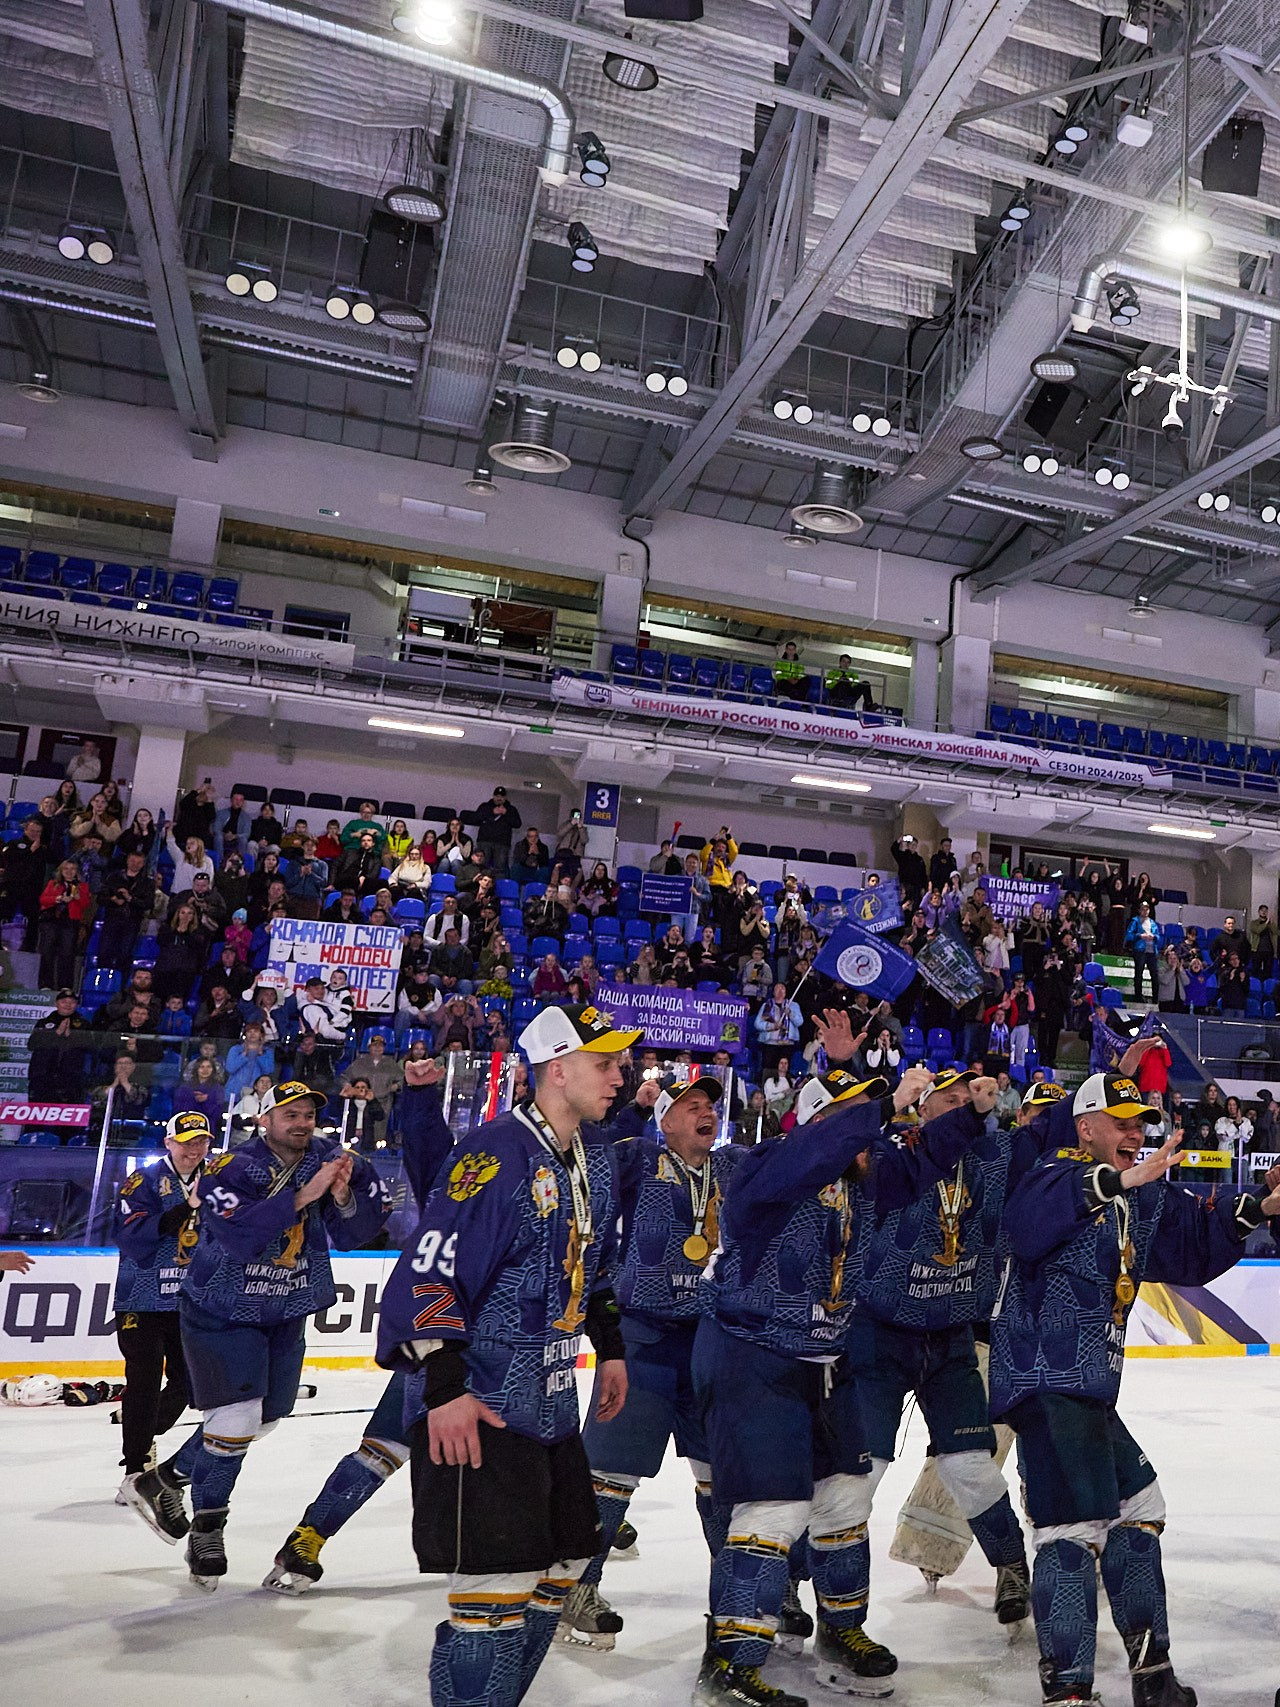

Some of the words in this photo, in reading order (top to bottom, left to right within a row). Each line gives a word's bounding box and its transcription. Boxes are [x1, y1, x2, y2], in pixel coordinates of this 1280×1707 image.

[0, 602, 60, 625] НИЯ
[207, 636, 256, 651] ЖИЛОЙ
[260, 644, 324, 661] КОМПЛЕКС
[632, 697, 718, 720] ЧЕМПИОНАТ
[721, 711, 777, 729] РОССИИ
[781, 720, 800, 732] ПО
[804, 723, 858, 741] ХОККЕЮ
[872, 733, 932, 751] ЖЕНСКАЯ
[936, 742, 1008, 762] ХОККЕЙНАЯ
[1010, 753, 1040, 767] ЛИГА
[1049, 760, 1085, 775] СЕЗОН
[1087, 766, 1144, 783] 2024/2025
[596, 788, 610, 809] 3
[988, 877, 1050, 894] ПОКАЖИТЕ
[997, 890, 1036, 905] КЛАСС
[271, 918, 346, 946] КОМАНДА
[320, 945, 392, 968] МОЛОДЕЦ
[598, 988, 629, 1006] НАША
[631, 993, 683, 1012] КОМАНДА
[693, 1001, 745, 1017] ЧЕМПИОН!
[0, 1007, 48, 1018] YNERGETIC
[637, 1012, 649, 1024] ЗА
[650, 1014, 667, 1025] ВАС
[669, 1016, 702, 1029] БОЛЕЕТ
[685, 1032, 716, 1046] РАЙОН!
[0, 1066, 27, 1076] GETIC
[0, 1105, 89, 1122] FONBET
[1201, 1155, 1223, 1163] БАНК
[954, 1276, 972, 1293] СУД
[412, 1283, 466, 1332] Z
